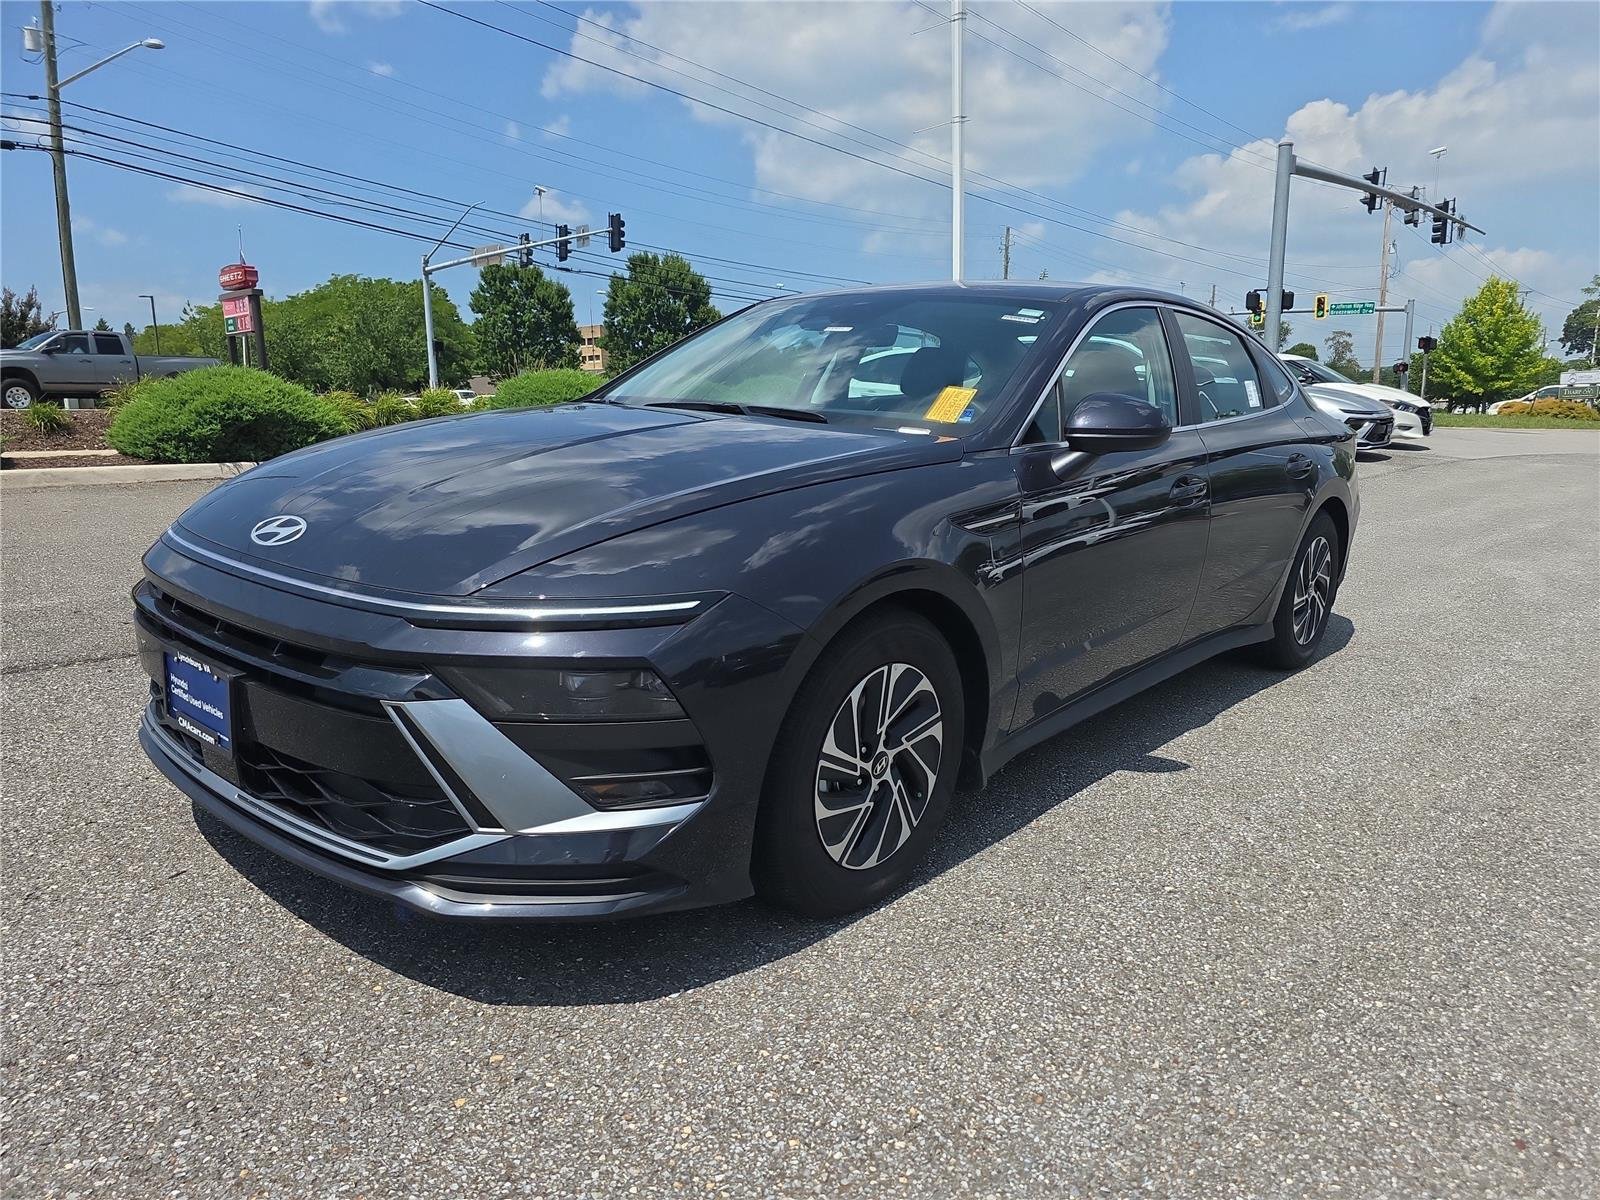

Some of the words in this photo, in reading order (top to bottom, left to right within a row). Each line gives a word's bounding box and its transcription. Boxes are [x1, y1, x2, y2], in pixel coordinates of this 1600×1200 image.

[219, 272, 243, 283] SHEETZ
[203, 663, 211, 673] VA
[170, 673, 188, 690] Hyundai
[171, 684, 188, 701] Certified
[189, 694, 201, 708] Used
[201, 700, 223, 719] Vehicles
